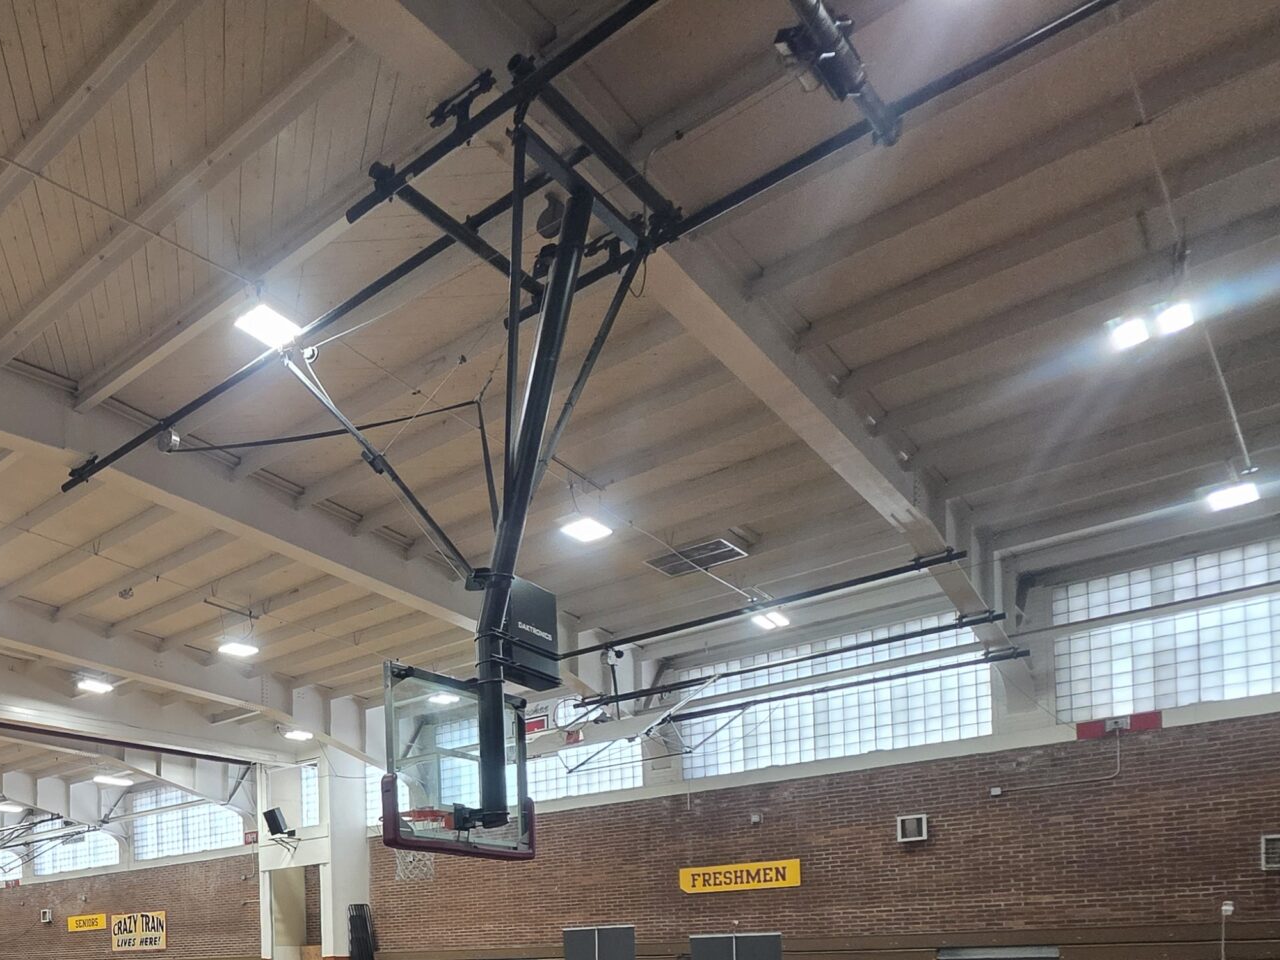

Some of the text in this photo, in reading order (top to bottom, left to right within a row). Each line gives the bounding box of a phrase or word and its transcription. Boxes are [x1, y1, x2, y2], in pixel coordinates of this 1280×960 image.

[691, 866, 787, 888] FRESHMEN
[75, 918, 98, 928] SENIORS
[112, 913, 164, 936] CRAZY TRAIN
[117, 936, 161, 947] LIVES HERE!
